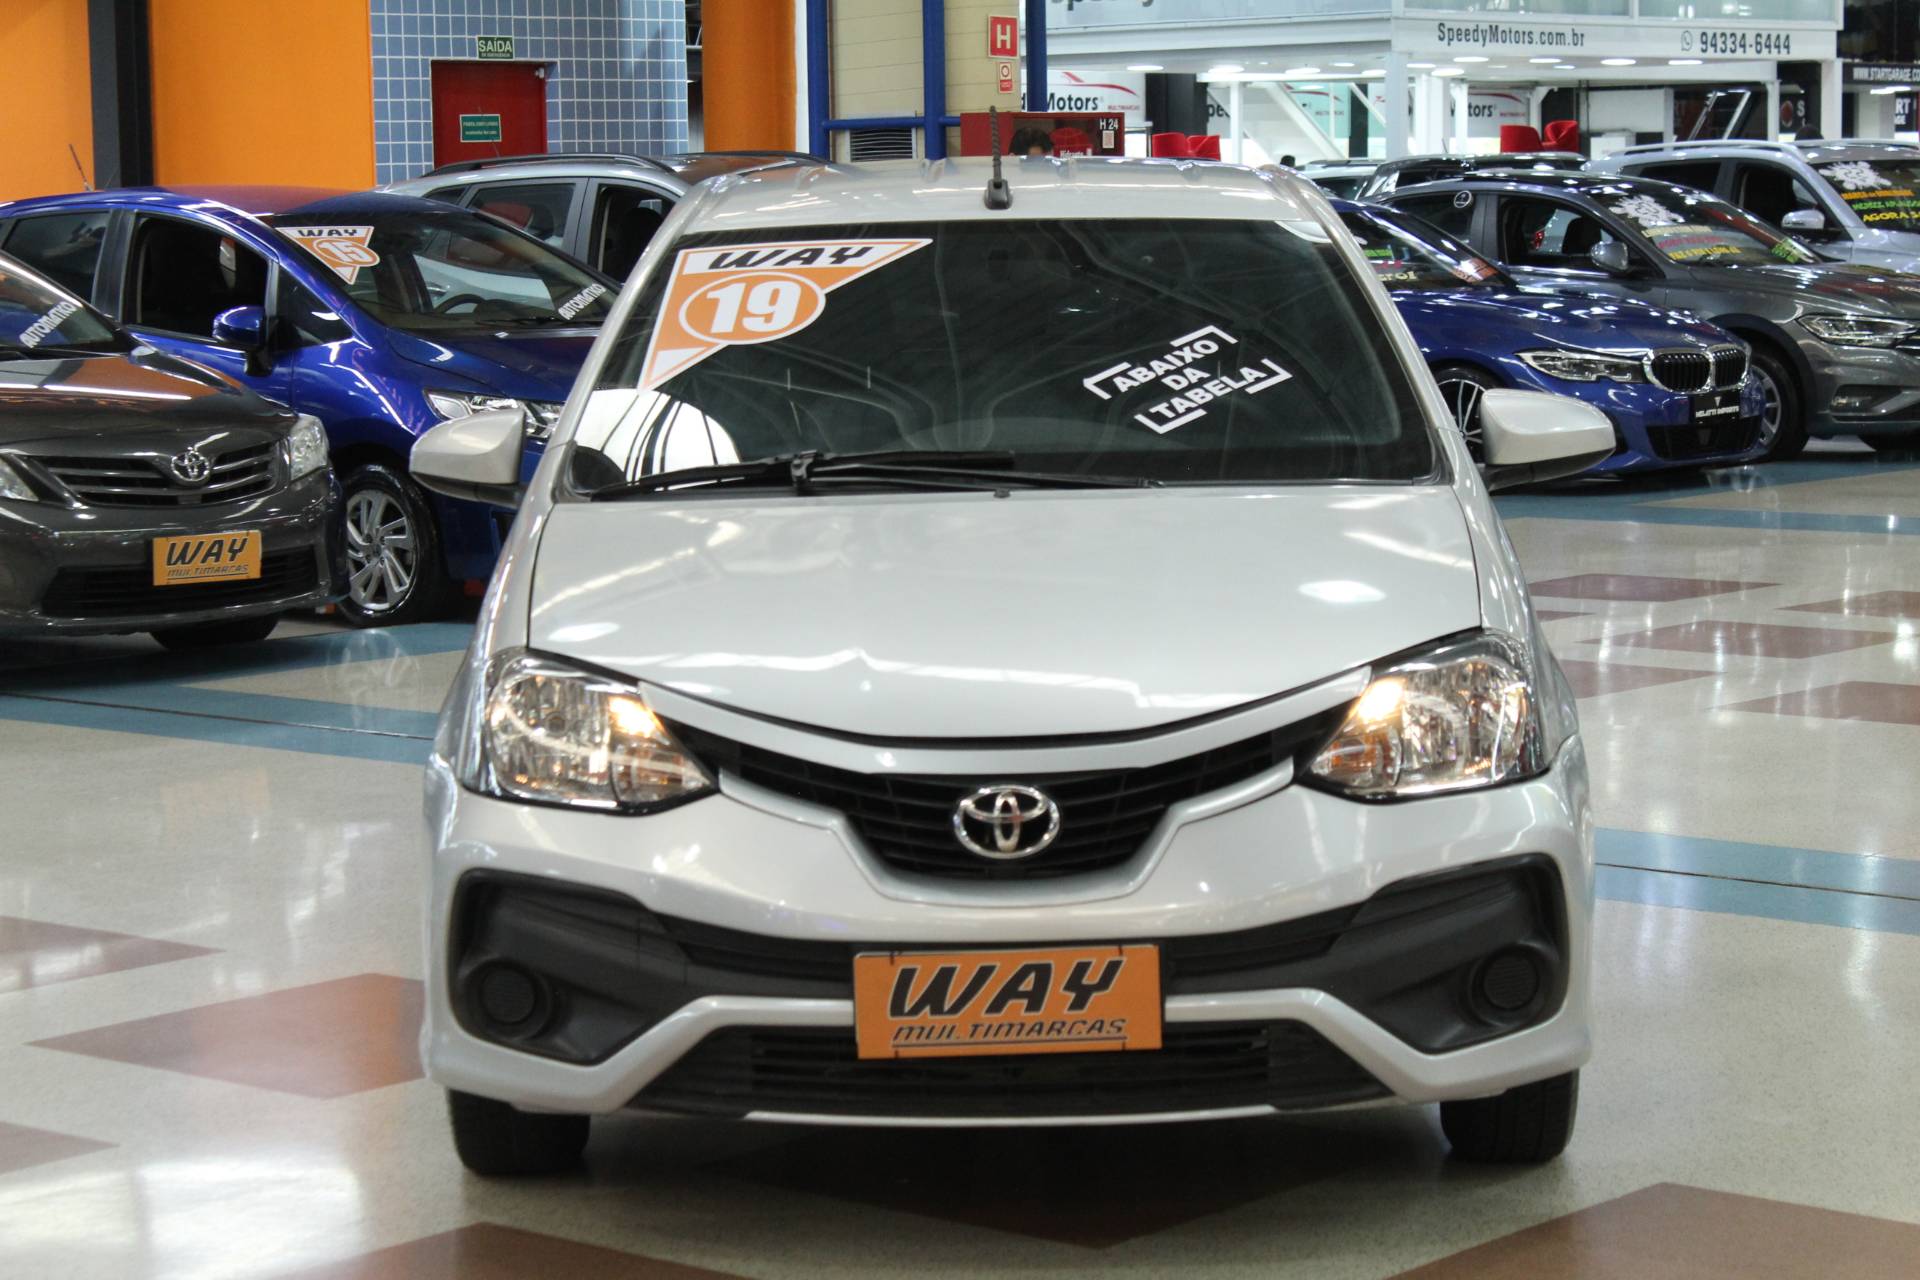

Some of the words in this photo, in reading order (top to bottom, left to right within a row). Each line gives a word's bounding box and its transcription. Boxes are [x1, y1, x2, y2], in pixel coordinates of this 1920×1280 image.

[479, 38, 512, 53] SAÍDA
[996, 24, 1011, 49] H
[1438, 22, 1585, 48] SpeedyMotors.com.br
[1700, 31, 1791, 54] 94334-6444
[1099, 118, 1106, 130] H
[1107, 118, 1119, 130] 24
[297, 228, 358, 238] WAY
[318, 241, 373, 262] 15
[708, 246, 873, 270] WAY
[706, 280, 801, 334] 19
[1112, 339, 1219, 393] ABAIXO
[1161, 367, 1211, 391] DA
[1149, 366, 1268, 419] TABELA
[166, 537, 248, 567] WAY
[167, 564, 249, 577] MULTIMARCAS
[888, 957, 1127, 1020] WAY
[892, 1018, 1127, 1042] MULTIMARCAS
